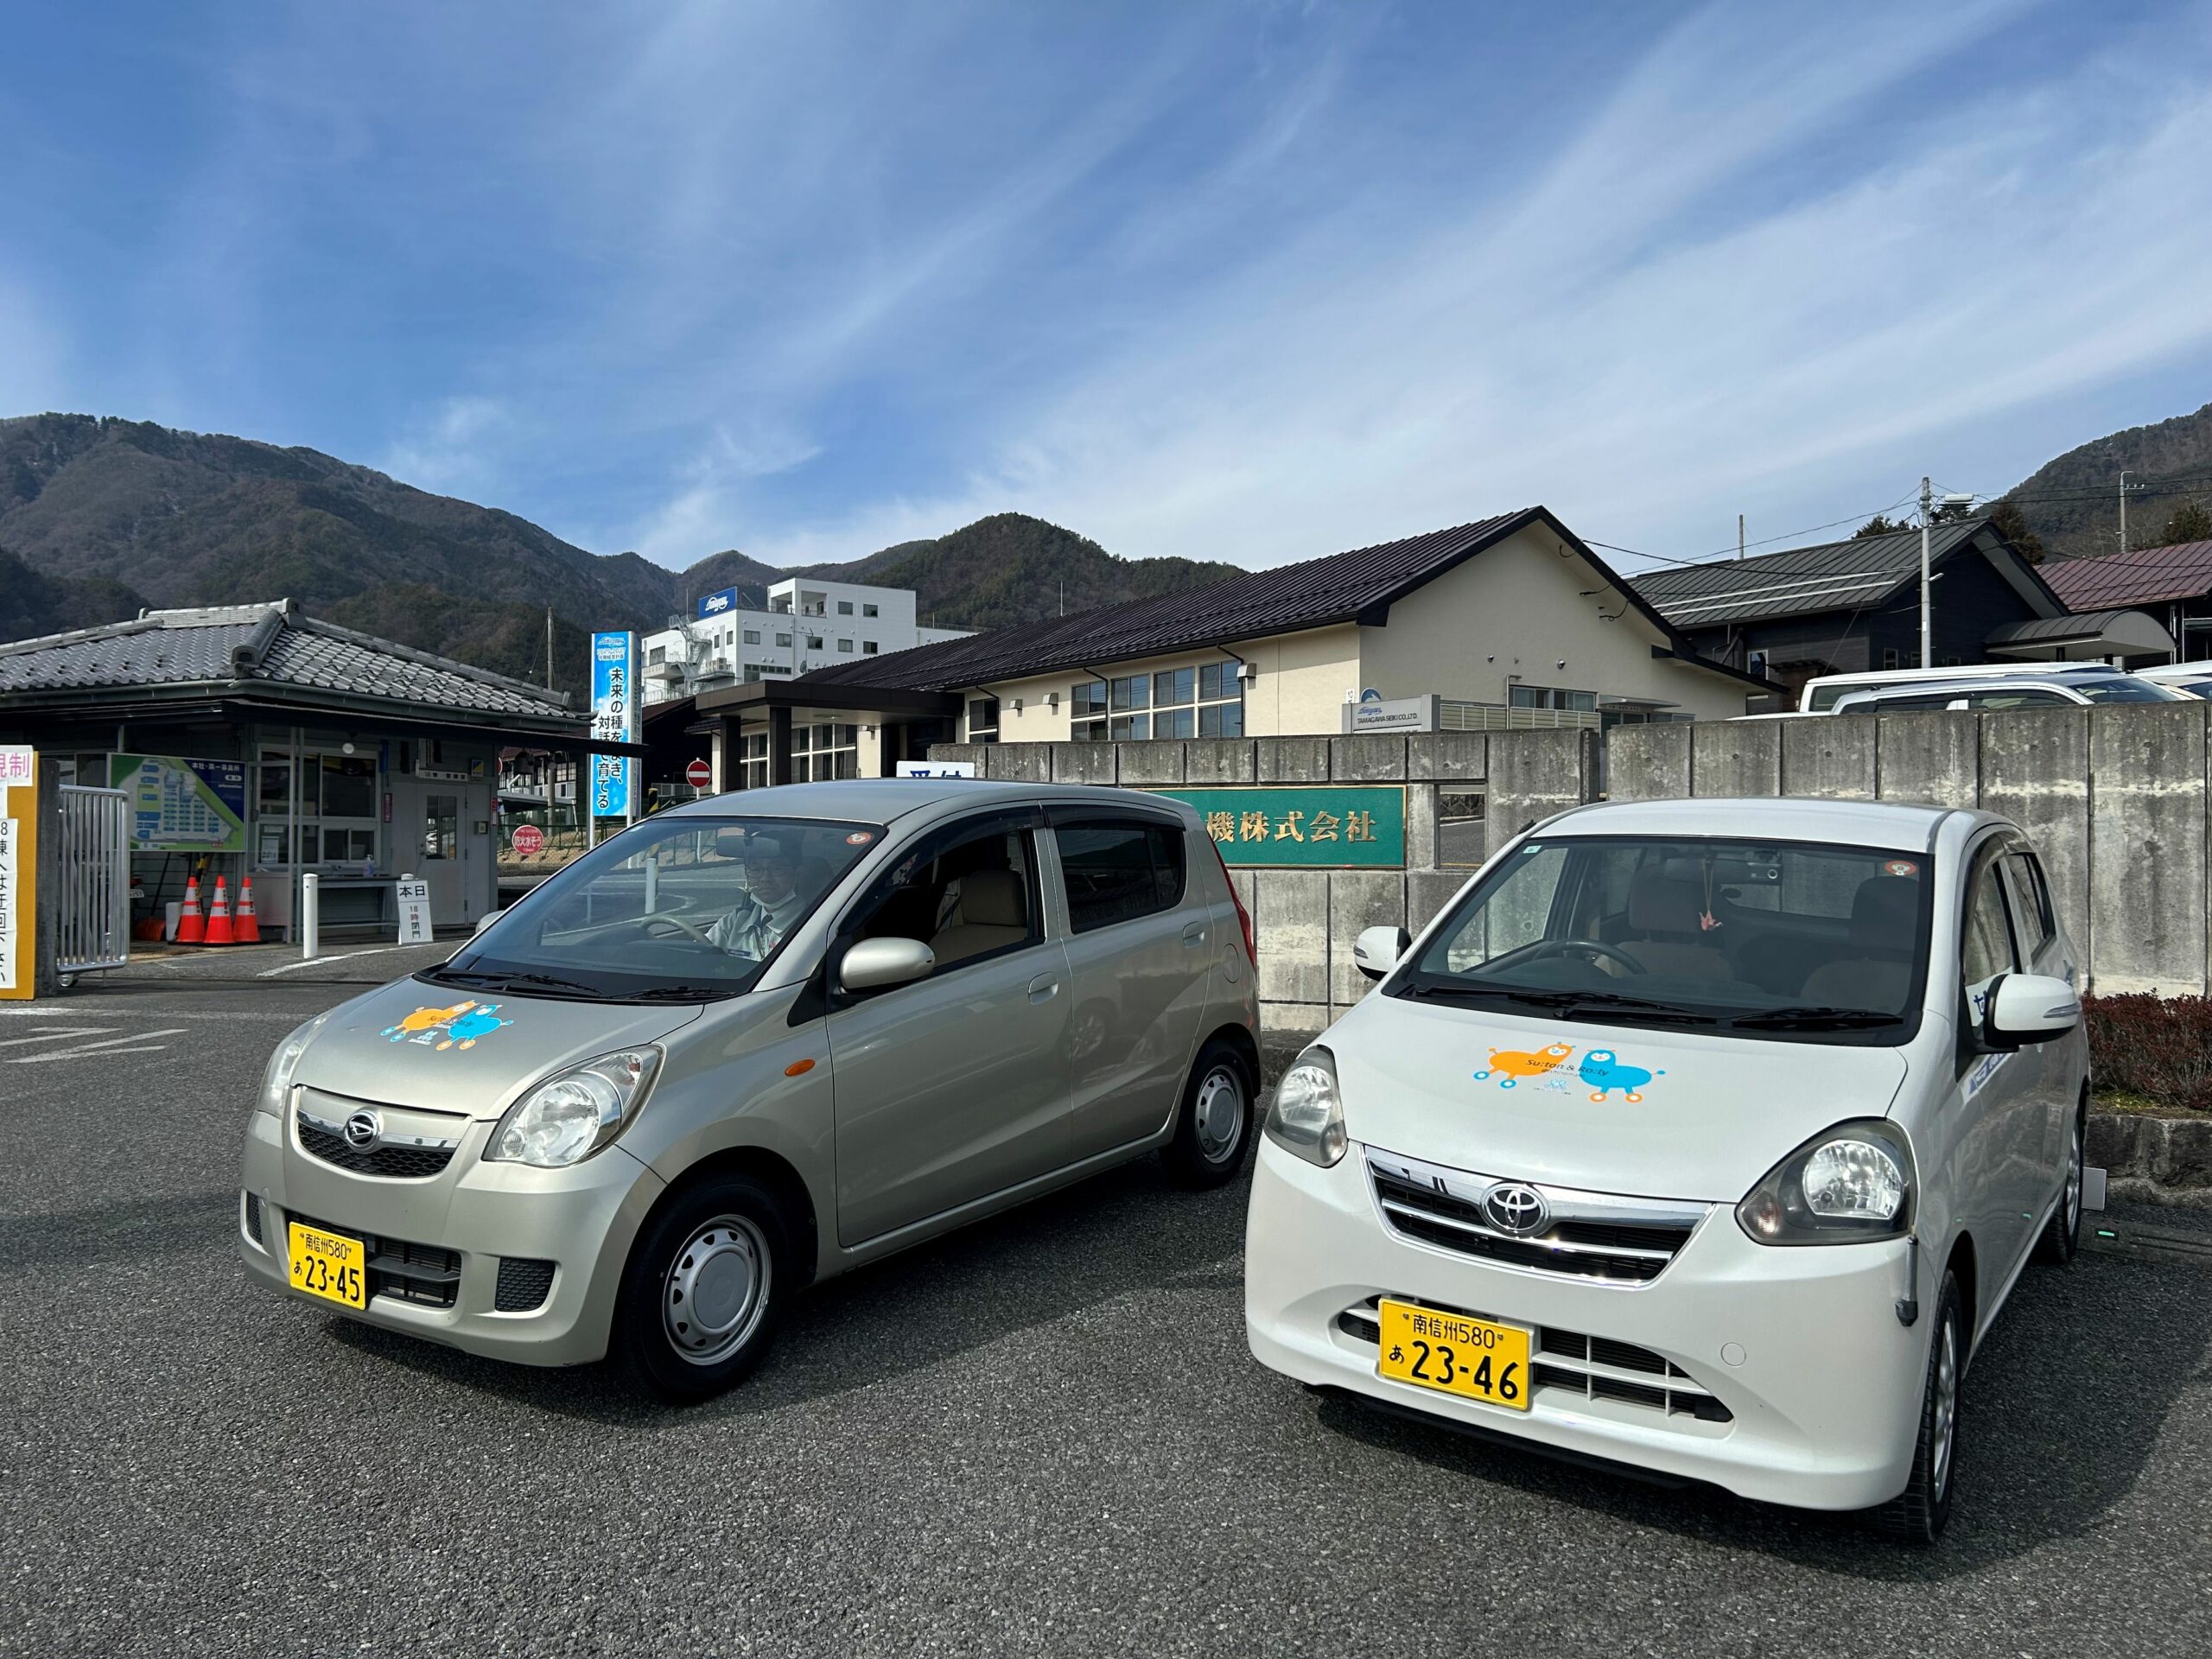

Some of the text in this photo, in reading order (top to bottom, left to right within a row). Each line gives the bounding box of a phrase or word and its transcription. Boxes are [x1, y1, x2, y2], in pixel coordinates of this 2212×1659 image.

[1205, 810, 1377, 843] 機株式会社
[398, 885, 426, 898] 本日
[294, 1255, 360, 1302] あ 23-45
[1389, 1340, 1519, 1400] あ 23-46
